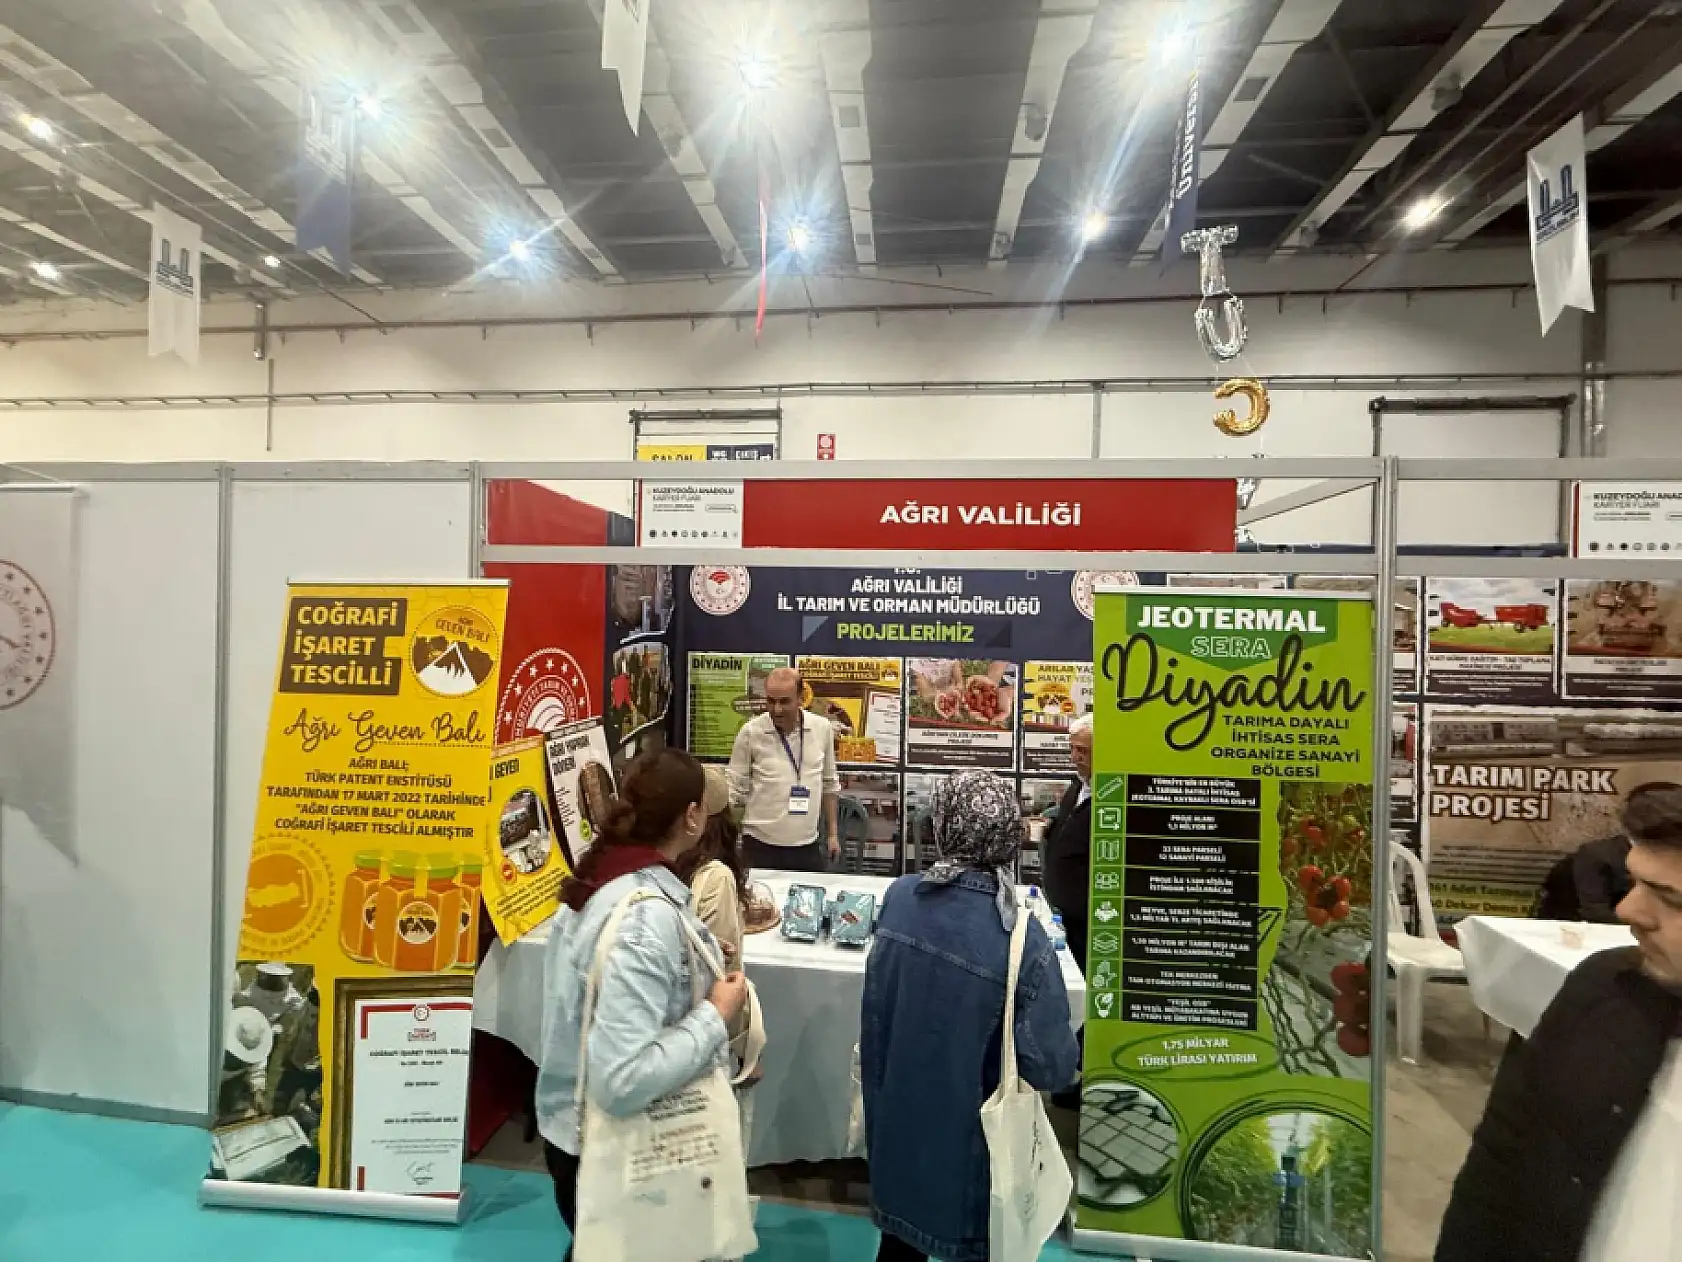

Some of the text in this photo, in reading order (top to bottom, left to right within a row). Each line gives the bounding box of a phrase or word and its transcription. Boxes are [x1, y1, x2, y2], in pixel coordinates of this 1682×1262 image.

[881, 500, 1081, 526] AĞRI VALİLİĞİ
[852, 575, 963, 595] AĞRI VALİLİĞİ
[298, 601, 398, 626] COĞRAFİ
[777, 592, 1041, 615] İL TARIM VE ORMAN MÜDÜRLÜĞÜ
[1137, 605, 1326, 633] JEOTERMAL
[837, 620, 974, 642] PROJELERİMİZ
[294, 630, 376, 660] İŞARET
[1190, 636, 1272, 658] SERA
[291, 657, 392, 685] TESCİLLİ
[692, 655, 743, 670] DİYADİN
[1101, 632, 1368, 751] Diyadin
[283, 708, 486, 752] Ağrı Geven Balı
[1223, 714, 1350, 730] TARIMA DAYALI
[1232, 727, 1340, 746] İHTİSAS SERA
[349, 756, 378, 770] AĞRI
[1210, 745, 1361, 763] ORGANİZE SANAYİ
[306, 769, 452, 788] TÜRK PATENT ENSTİTÜSÜ
[1251, 762, 1321, 778] BÖLGESİ
[1432, 765, 1615, 793] TARIM PARK
[267, 786, 486, 806] TARAFINDAN 17 MART 2022 TARİHİNDE
[1432, 791, 1550, 822] PROJESİ
[331, 805, 369, 817] GEVEN
[406, 809, 456, 822] OLARAK
[275, 817, 325, 831] COĞRAFİ
[327, 818, 368, 835] İŞARET
[416, 825, 475, 841] ALMIŞTIR
[1185, 1036, 1229, 1049] MİLYAR
[1137, 1053, 1258, 1067] TÜRK LİRASI YATIRIM
